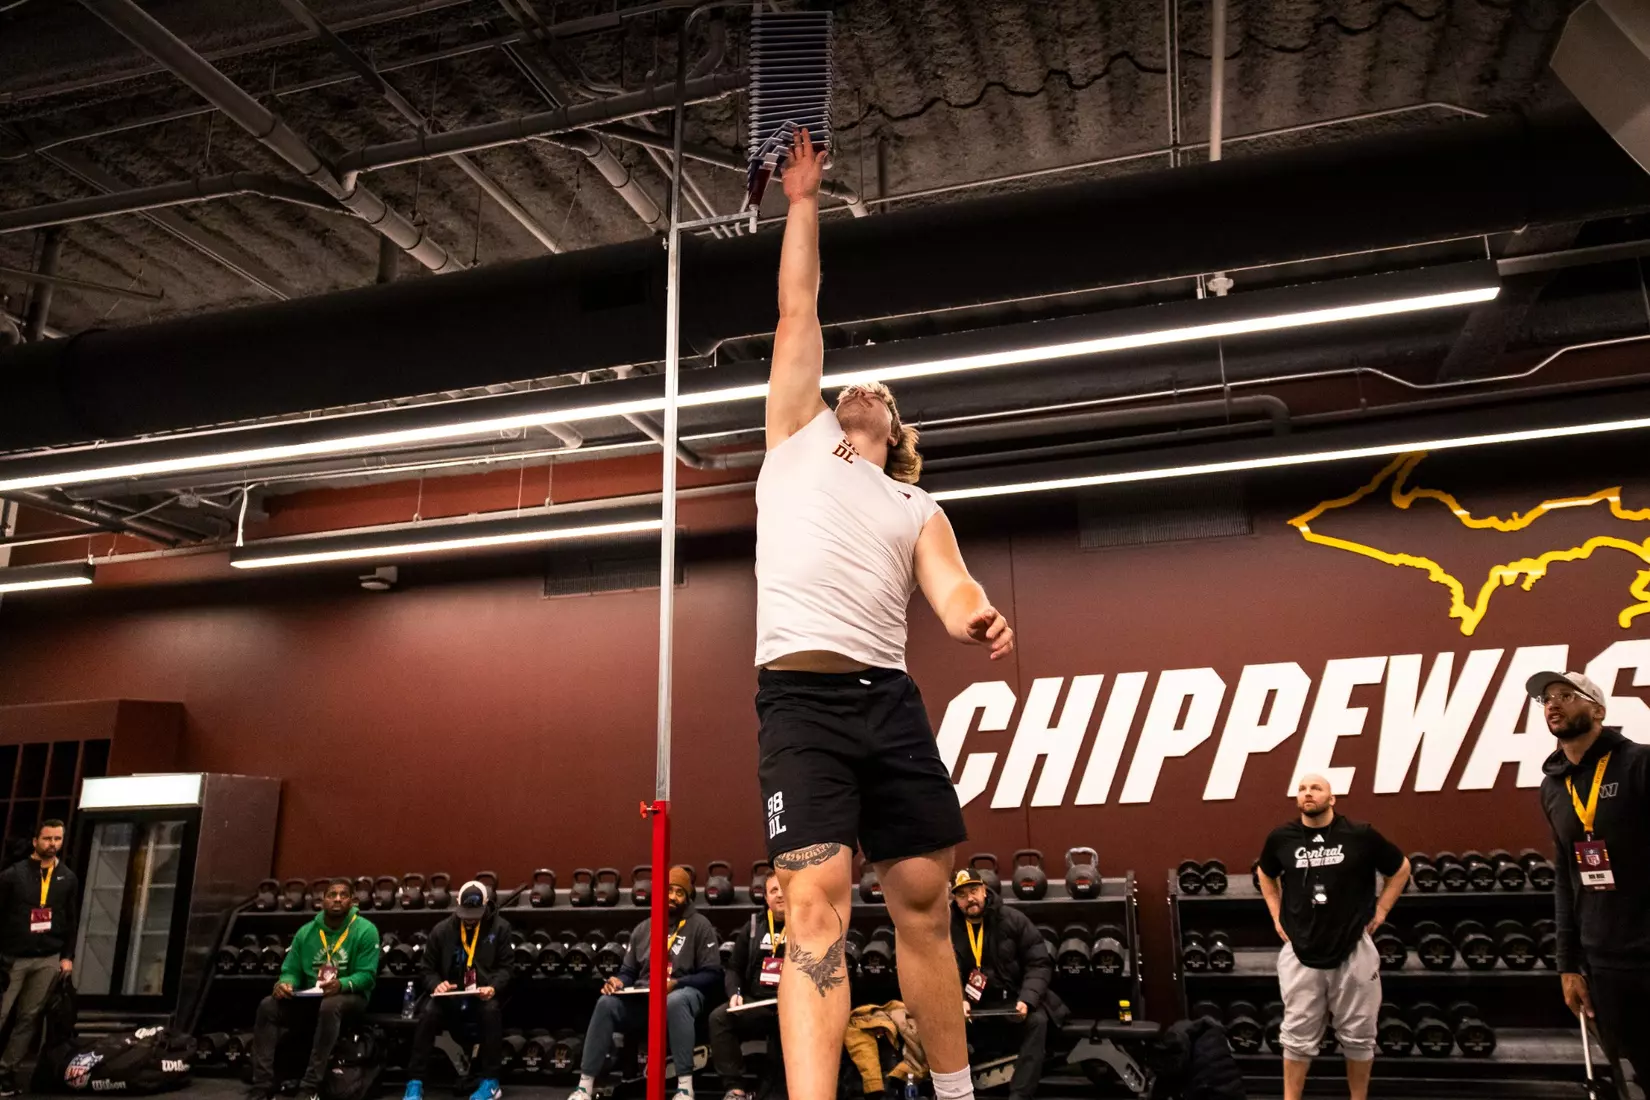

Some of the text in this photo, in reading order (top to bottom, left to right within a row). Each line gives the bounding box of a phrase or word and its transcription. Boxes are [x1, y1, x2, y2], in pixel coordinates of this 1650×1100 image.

[832, 444, 853, 464] DL
[768, 791, 783, 817] 98
[768, 815, 787, 839] DL
[1295, 844, 1343, 860] Central
